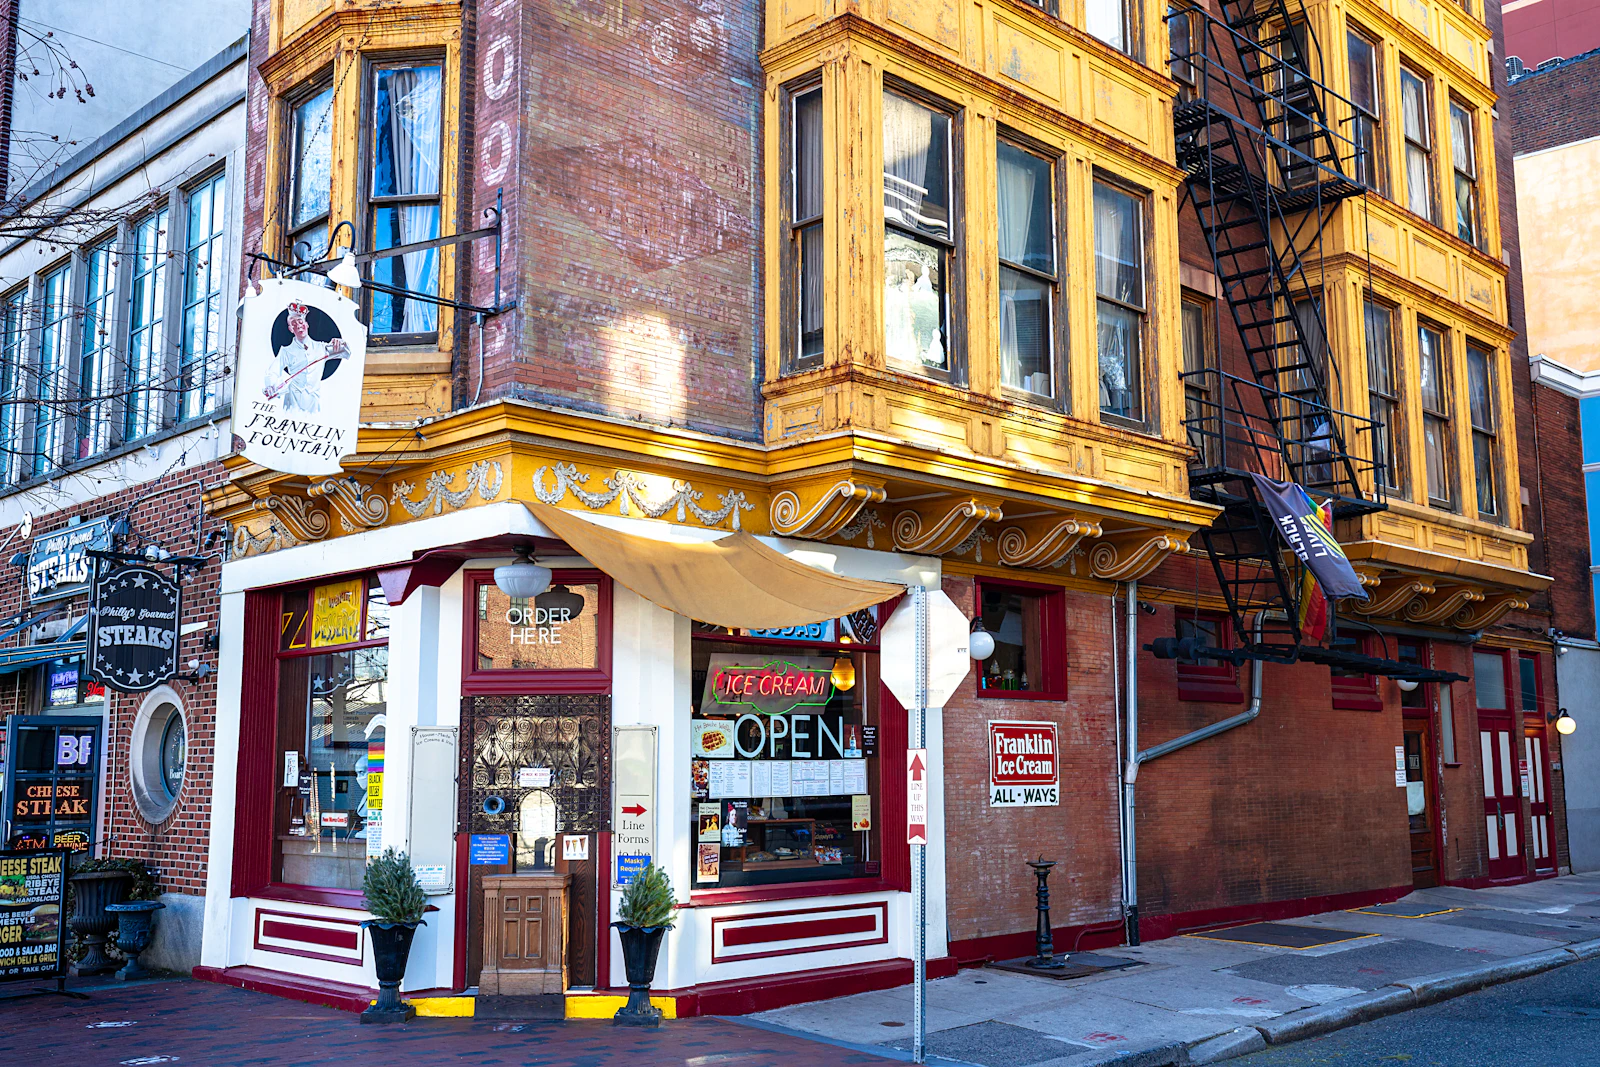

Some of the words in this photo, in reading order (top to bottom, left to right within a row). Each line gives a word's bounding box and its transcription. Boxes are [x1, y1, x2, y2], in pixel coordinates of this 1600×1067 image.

[252, 401, 276, 413] THE
[244, 413, 345, 444] FRANKLIN
[247, 431, 344, 460] FOUNTAIN
[1279, 514, 1309, 562] BLACK
[30, 552, 91, 593] STEAKS
[100, 606, 136, 621] Philly's
[138, 608, 175, 620] Gourmet
[506, 608, 570, 624] ORDER
[98, 625, 175, 650] STEAKS
[510, 627, 561, 644] HERE
[725, 675, 756, 695] ICE
[760, 675, 825, 696] CREAM
[734, 713, 844, 758] OPEN
[995, 733, 1053, 754] Franklin
[997, 755, 1015, 775] Ice
[1016, 755, 1053, 775] Cream
[913, 793, 921, 801] UP
[622, 820, 645, 830] Line
[16, 839, 46, 850] ATM
[54, 835, 81, 843] BEER
[63, 842, 88, 850] WINE
[618, 833, 650, 844] Forms
[0, 858, 27, 876] EESE
[30, 856, 62, 874] STEAK
[25, 878, 60, 888] RIBEYE
[28, 887, 59, 896] STEAK
[16, 895, 59, 904] HANDSLICED
[11, 910, 31, 918] BEEF
[0, 925, 22, 944] GER
[15, 947, 20, 956] &
[22, 945, 43, 956] SALAD
[45, 943, 57, 954] BAR
[17, 955, 31, 965] DELI
[33, 955, 37, 964] &
[39, 953, 57, 962] GRILL
